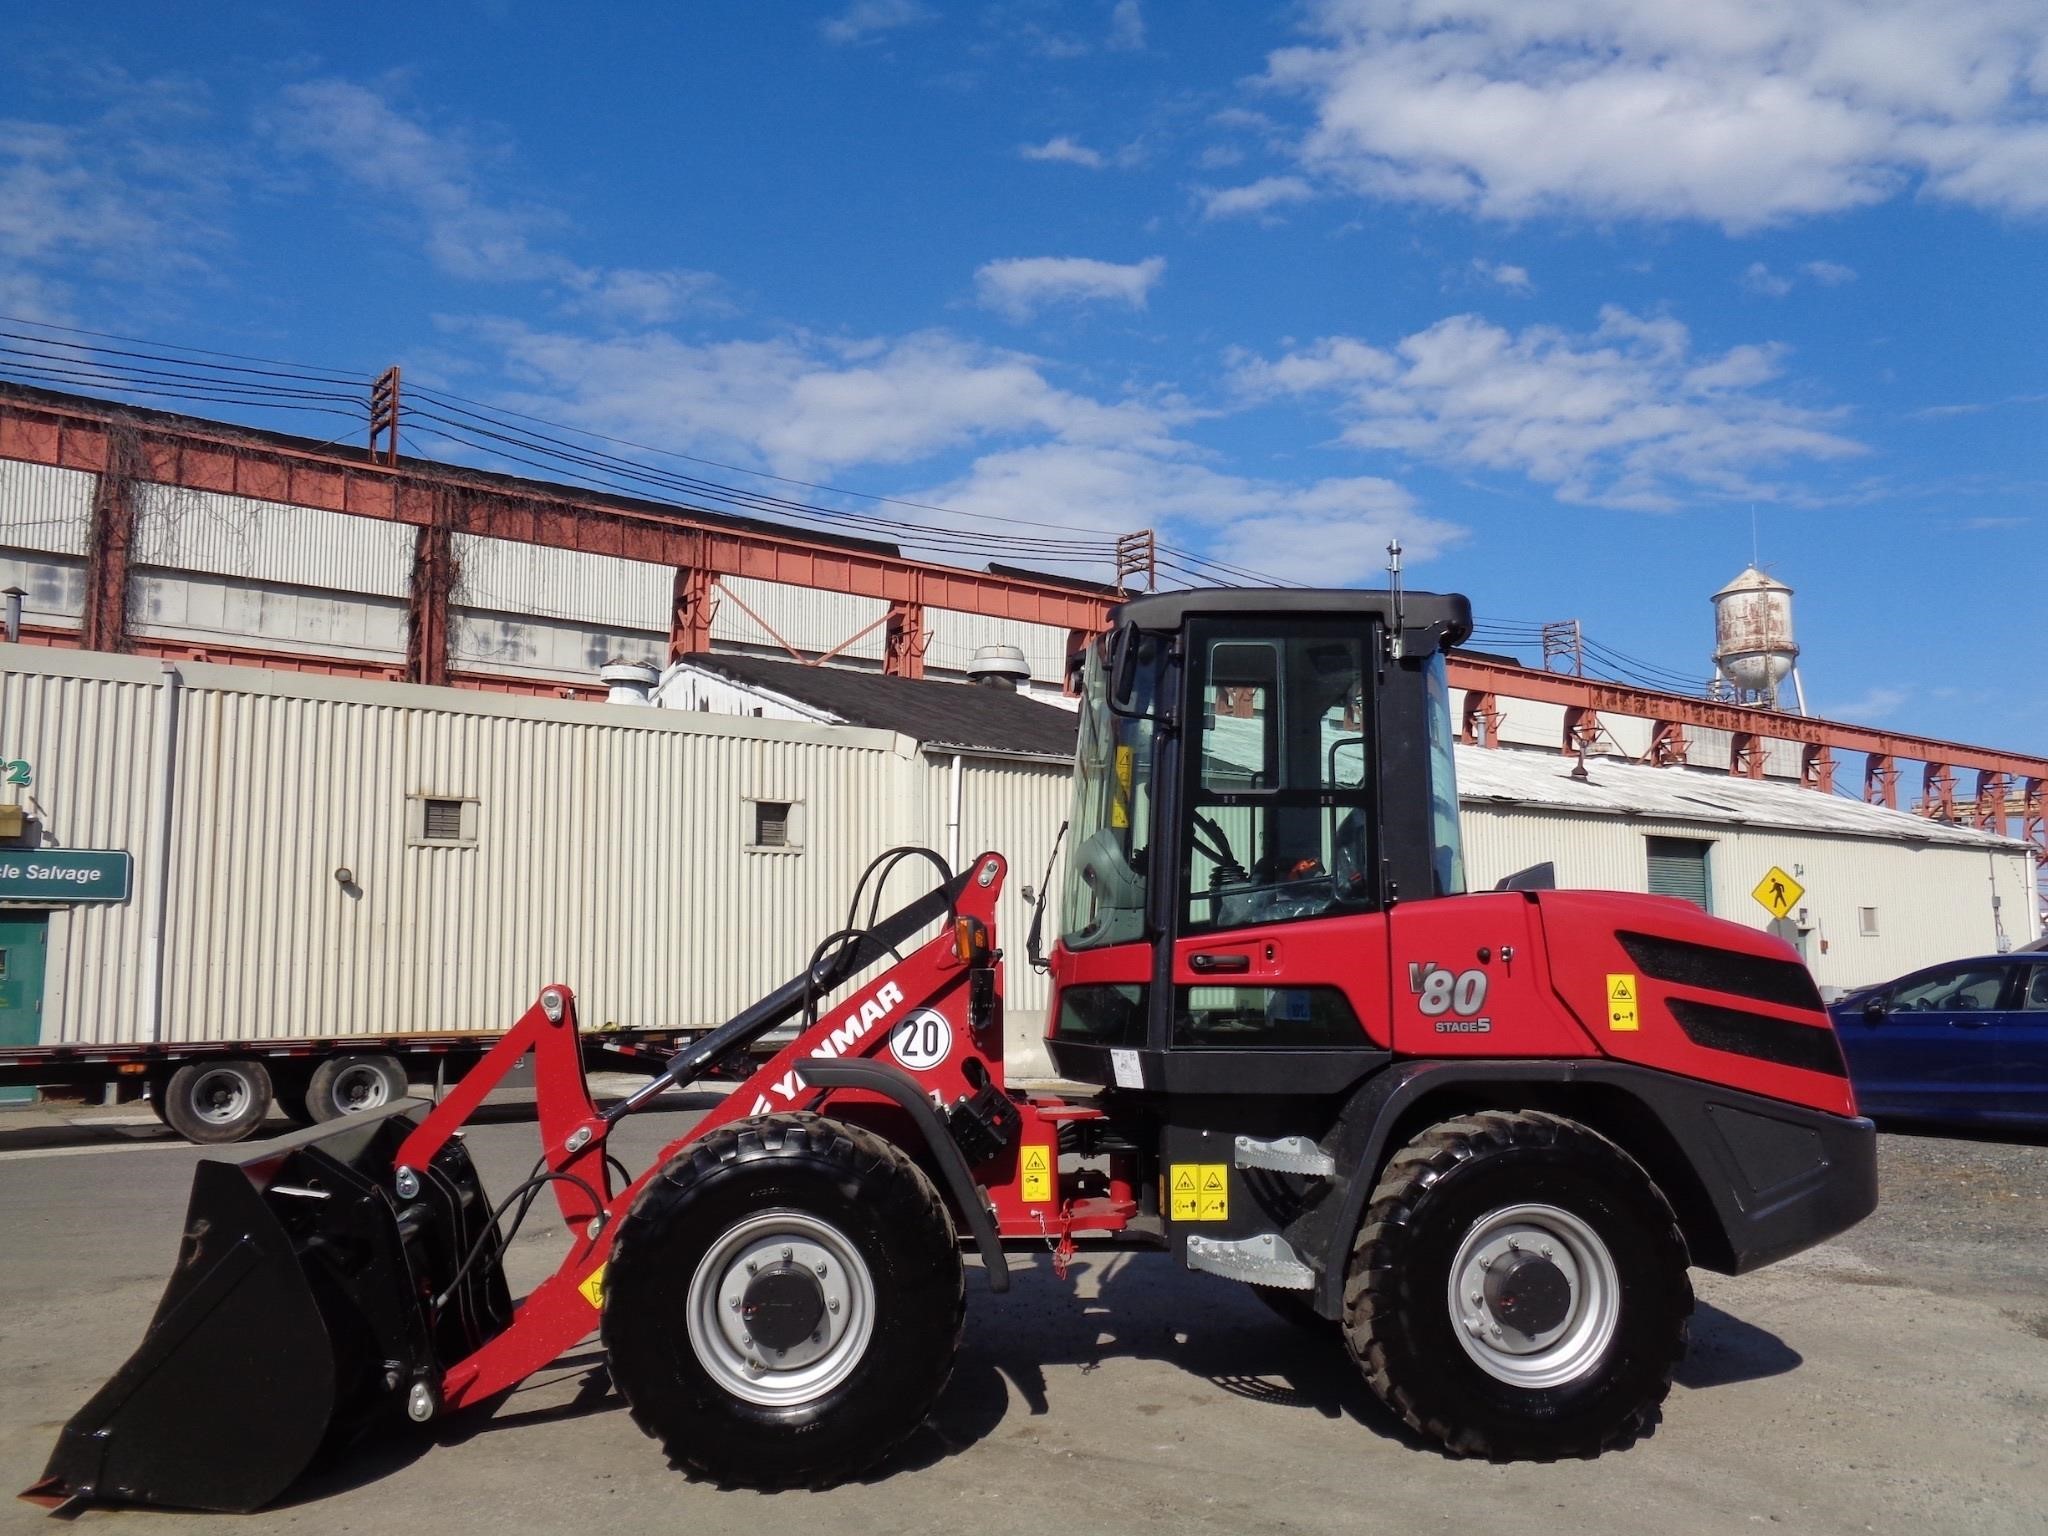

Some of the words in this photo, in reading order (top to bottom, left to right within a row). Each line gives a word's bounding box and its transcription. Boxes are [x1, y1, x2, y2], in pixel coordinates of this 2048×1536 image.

[0, 756, 31, 785] 2
[0, 864, 20, 879] le
[26, 865, 101, 884] Salvage
[1408, 962, 1487, 1016] V80
[770, 981, 903, 1101] YNMAR
[901, 1020, 939, 1057] 20
